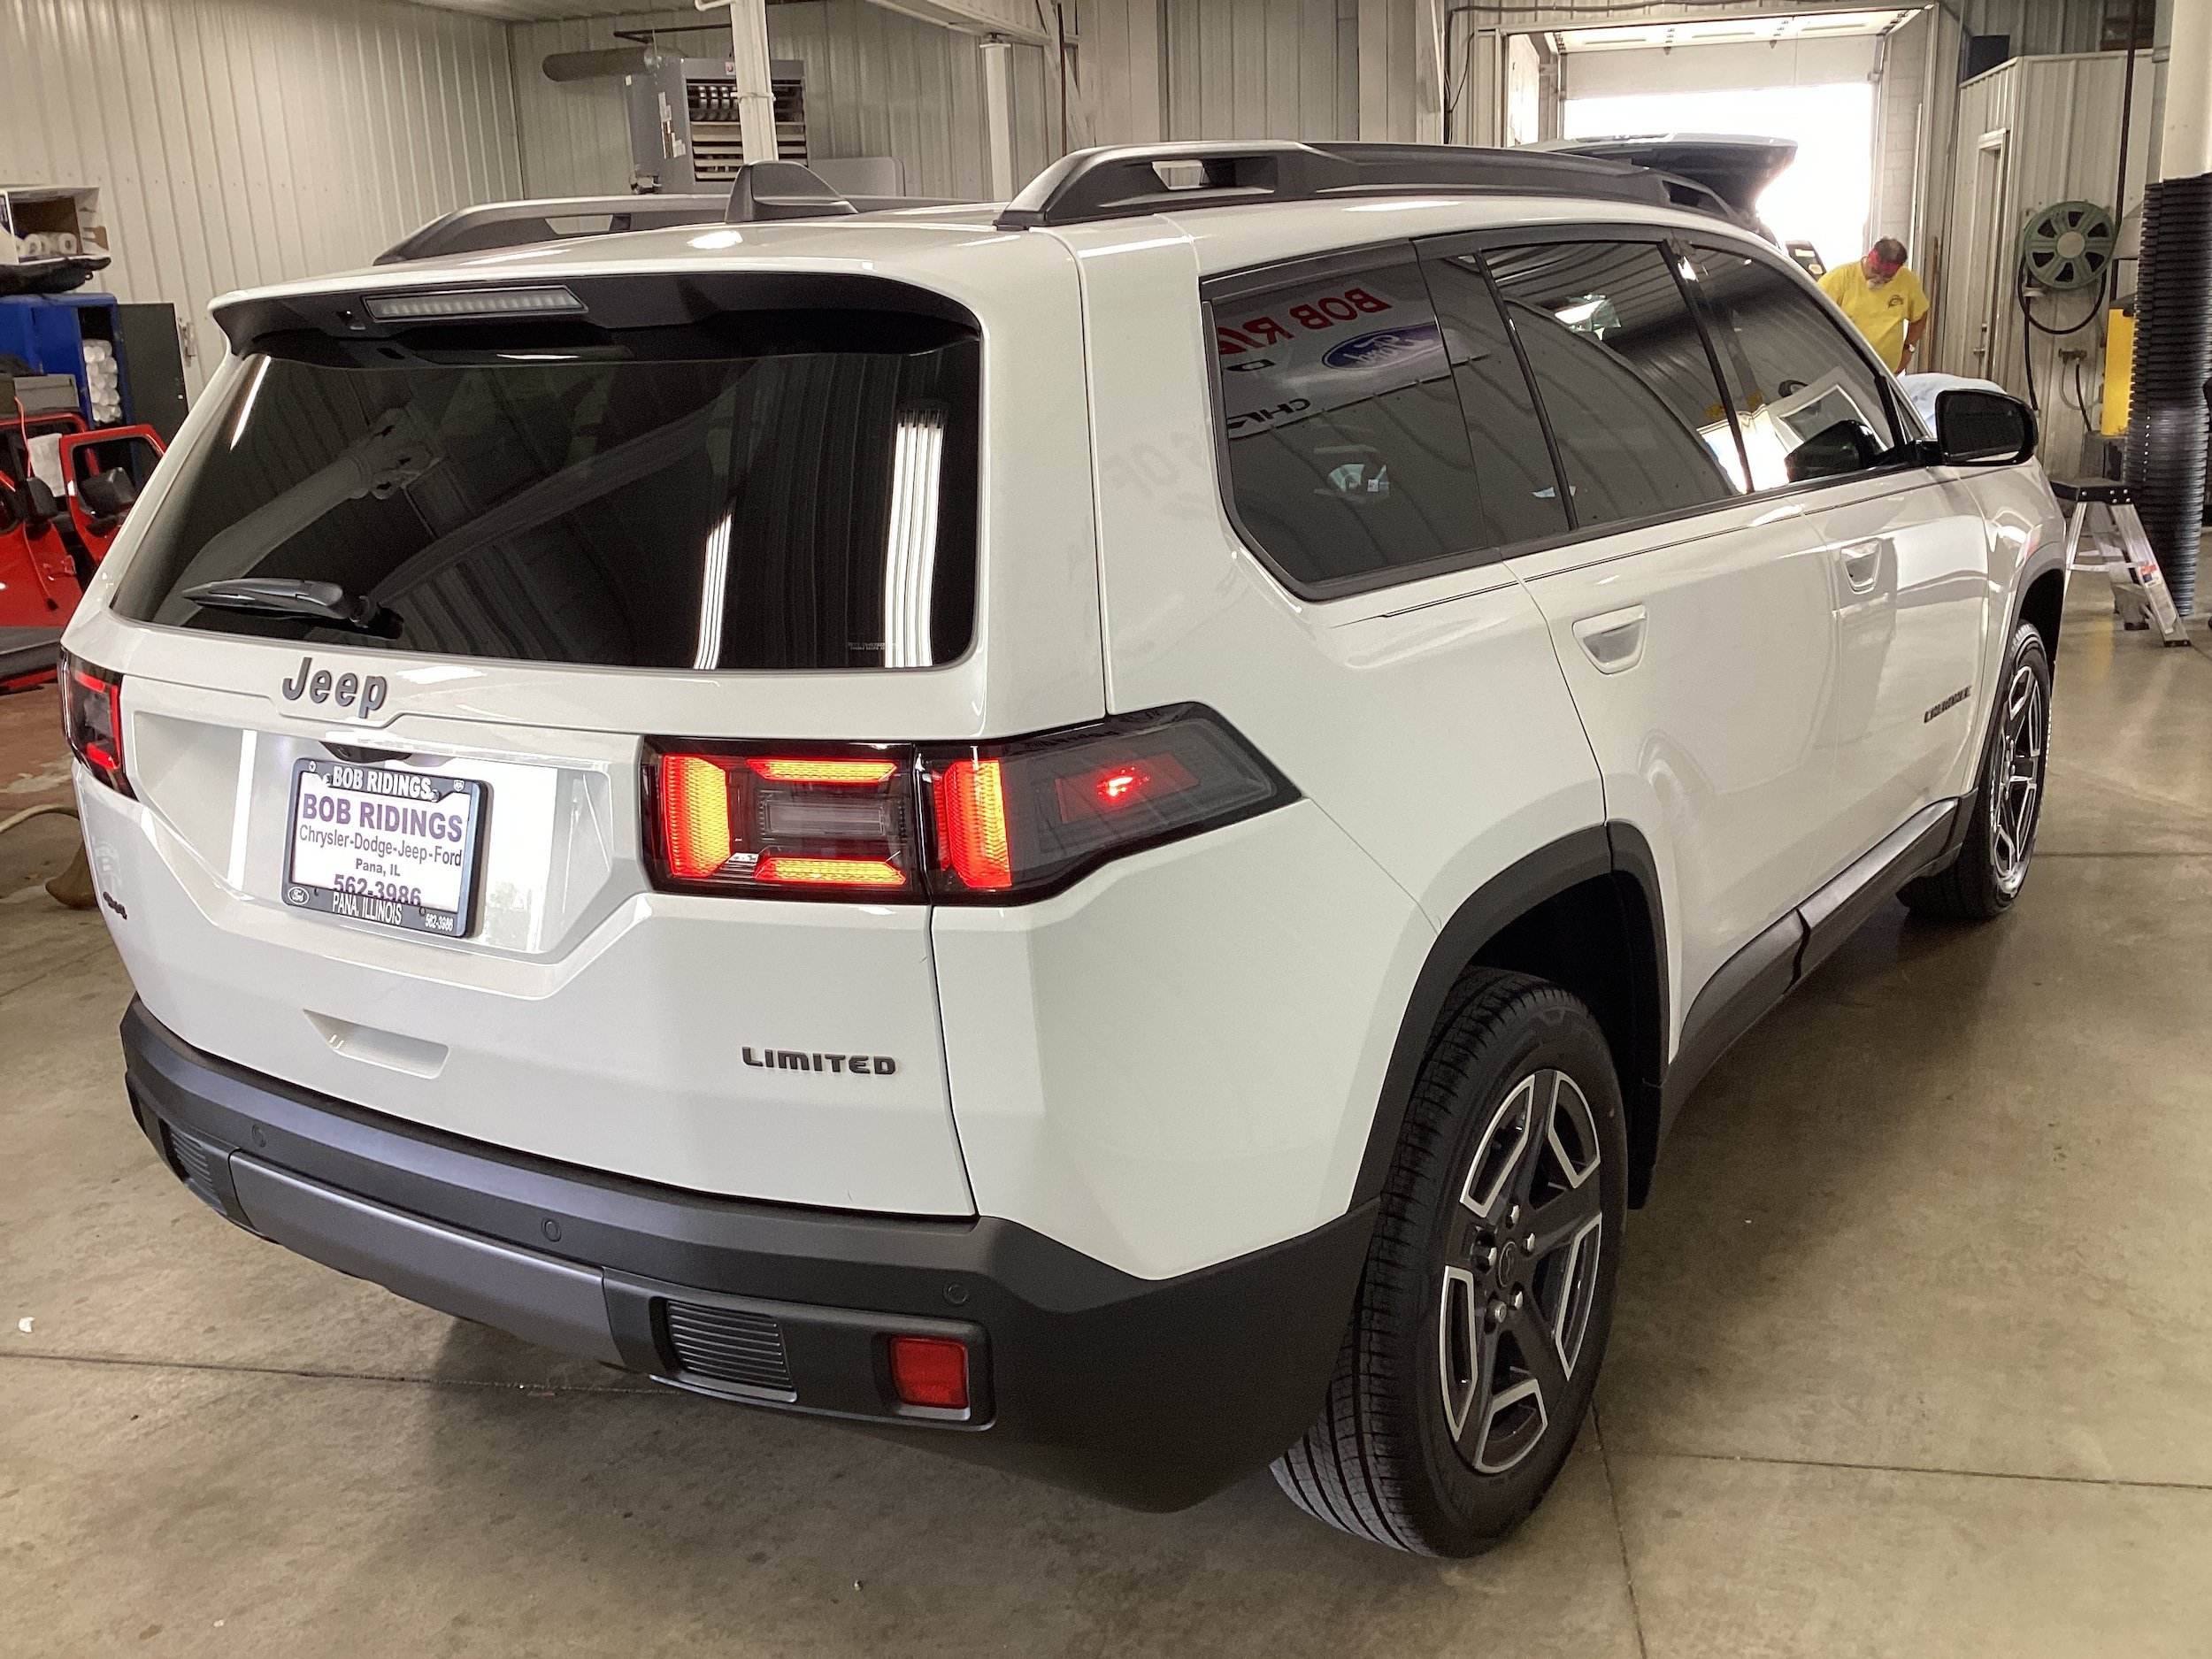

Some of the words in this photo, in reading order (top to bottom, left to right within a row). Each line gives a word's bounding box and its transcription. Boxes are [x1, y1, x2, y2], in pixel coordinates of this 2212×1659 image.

[281, 657, 388, 718] Jeep
[333, 765, 364, 790] BOB
[367, 771, 432, 798] RIDINGS
[302, 793, 351, 825] BOB
[359, 802, 463, 842] RIDINGS
[299, 824, 463, 866] Chrysler-Dodge-Jeep-Ford
[356, 858, 386, 876] Pana,
[389, 864, 401, 876] IL
[334, 874, 422, 905] 562-3986
[362, 896, 402, 925] ILLINOIS
[741, 1046, 895, 1075] LIMITED
